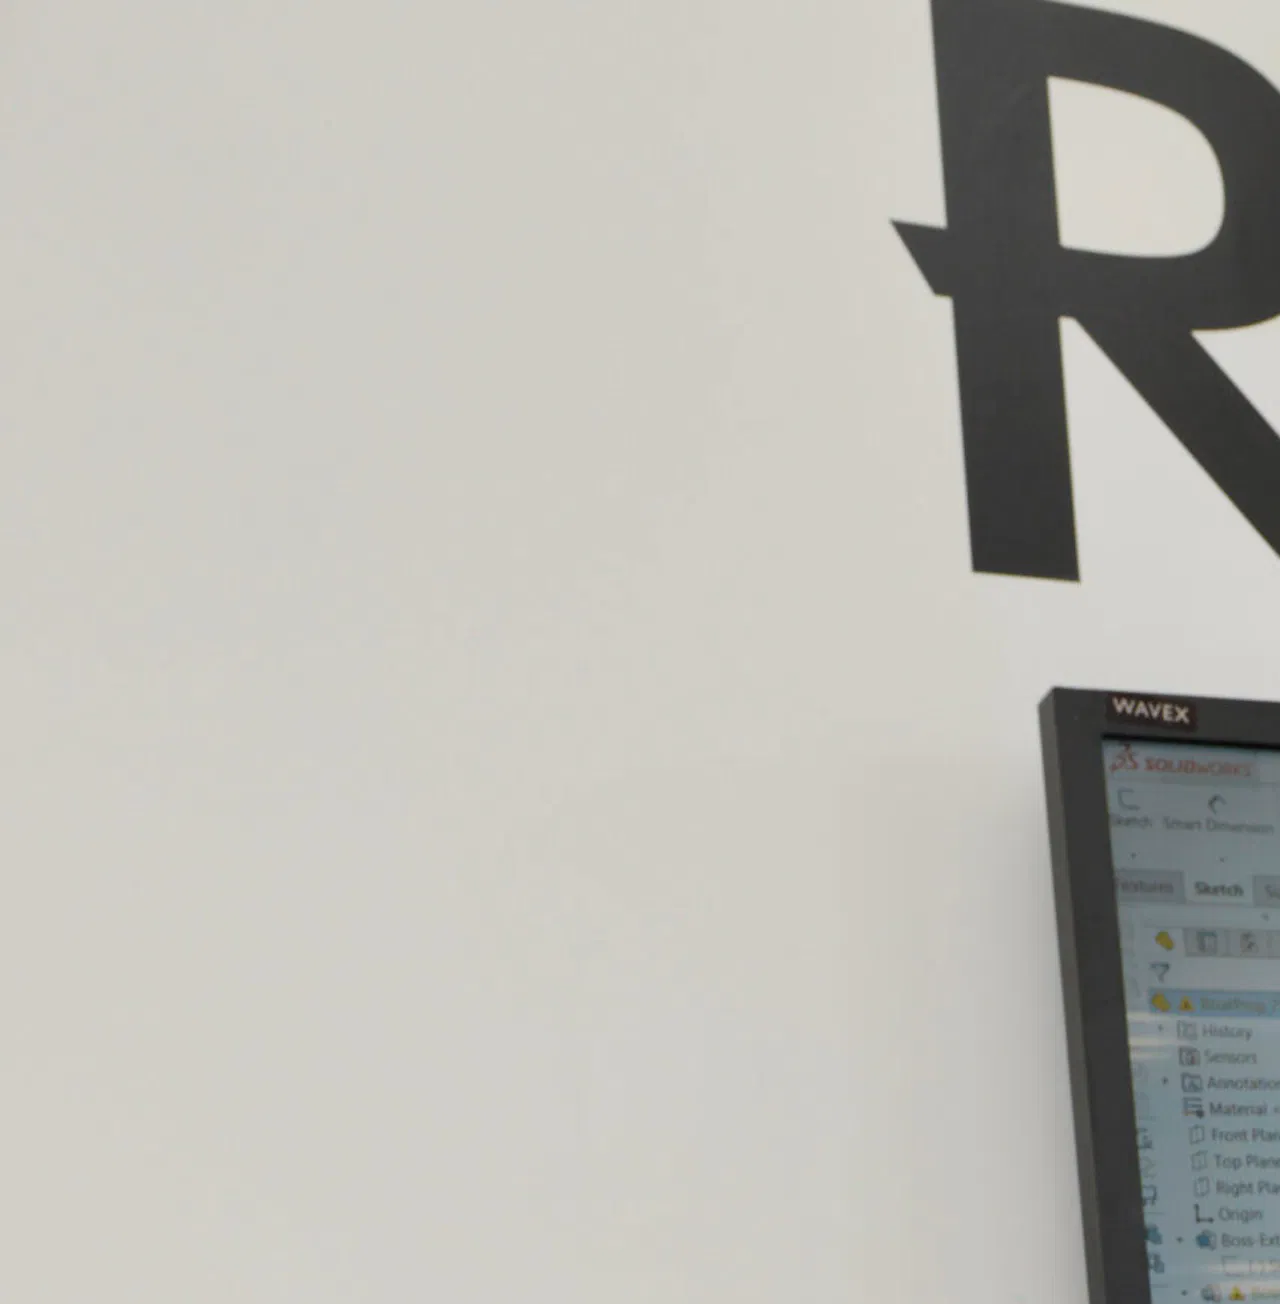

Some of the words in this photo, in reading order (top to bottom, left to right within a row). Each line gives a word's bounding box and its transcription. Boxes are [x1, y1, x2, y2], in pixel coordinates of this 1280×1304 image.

[1112, 697, 1190, 724] WAVEX
[1194, 881, 1244, 898] Sketch
[1202, 1022, 1253, 1040] History
[1208, 1102, 1268, 1117] Material
[1210, 1127, 1250, 1143] Front
[1213, 1153, 1242, 1171] Top
[1215, 1181, 1251, 1199] Right
[1218, 1205, 1264, 1223] Origin
